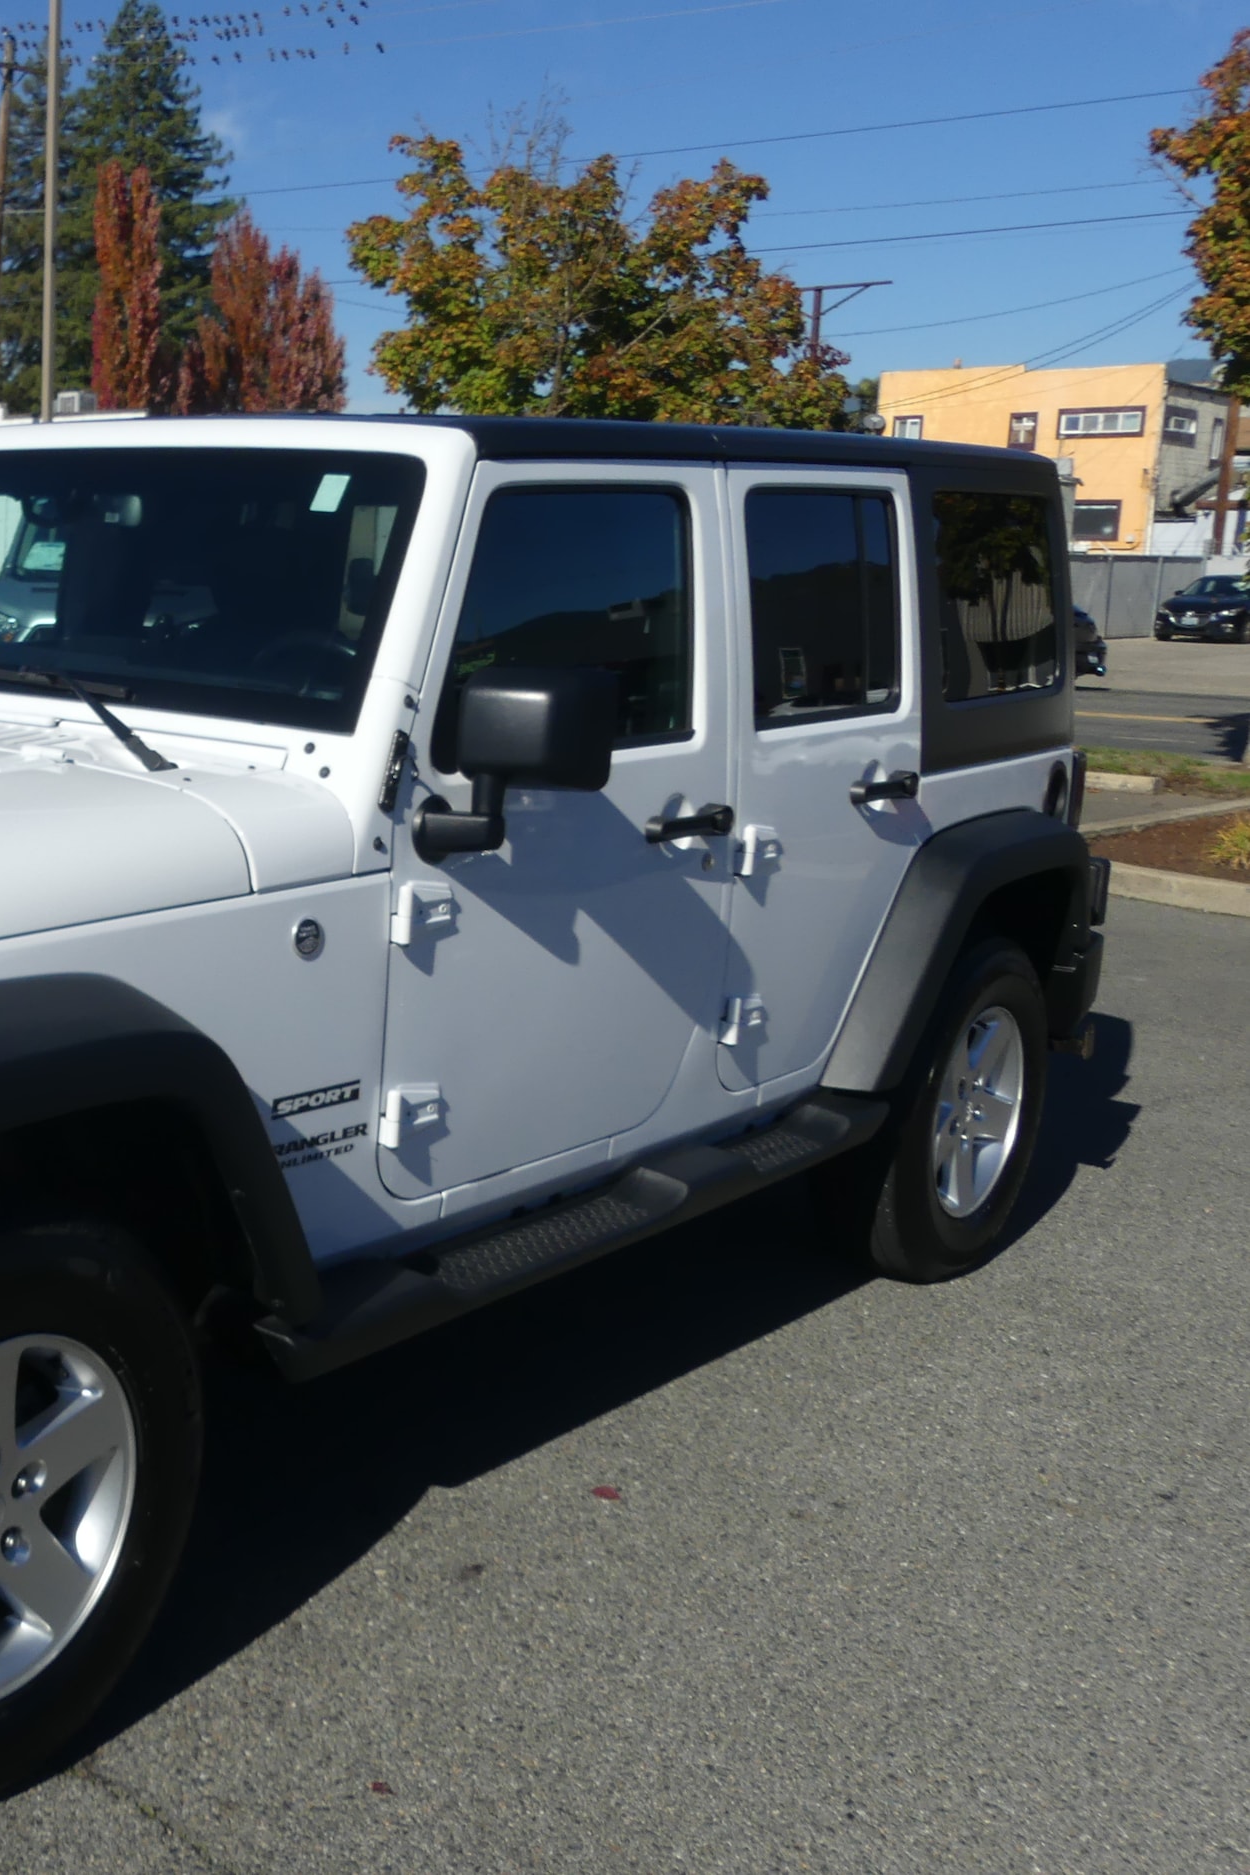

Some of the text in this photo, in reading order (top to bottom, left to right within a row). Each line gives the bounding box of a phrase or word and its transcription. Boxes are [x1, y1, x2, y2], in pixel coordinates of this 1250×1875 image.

[275, 1084, 360, 1115] SPORT
[272, 1122, 369, 1157] RANGLER
[281, 1143, 355, 1169] NLIMITED
